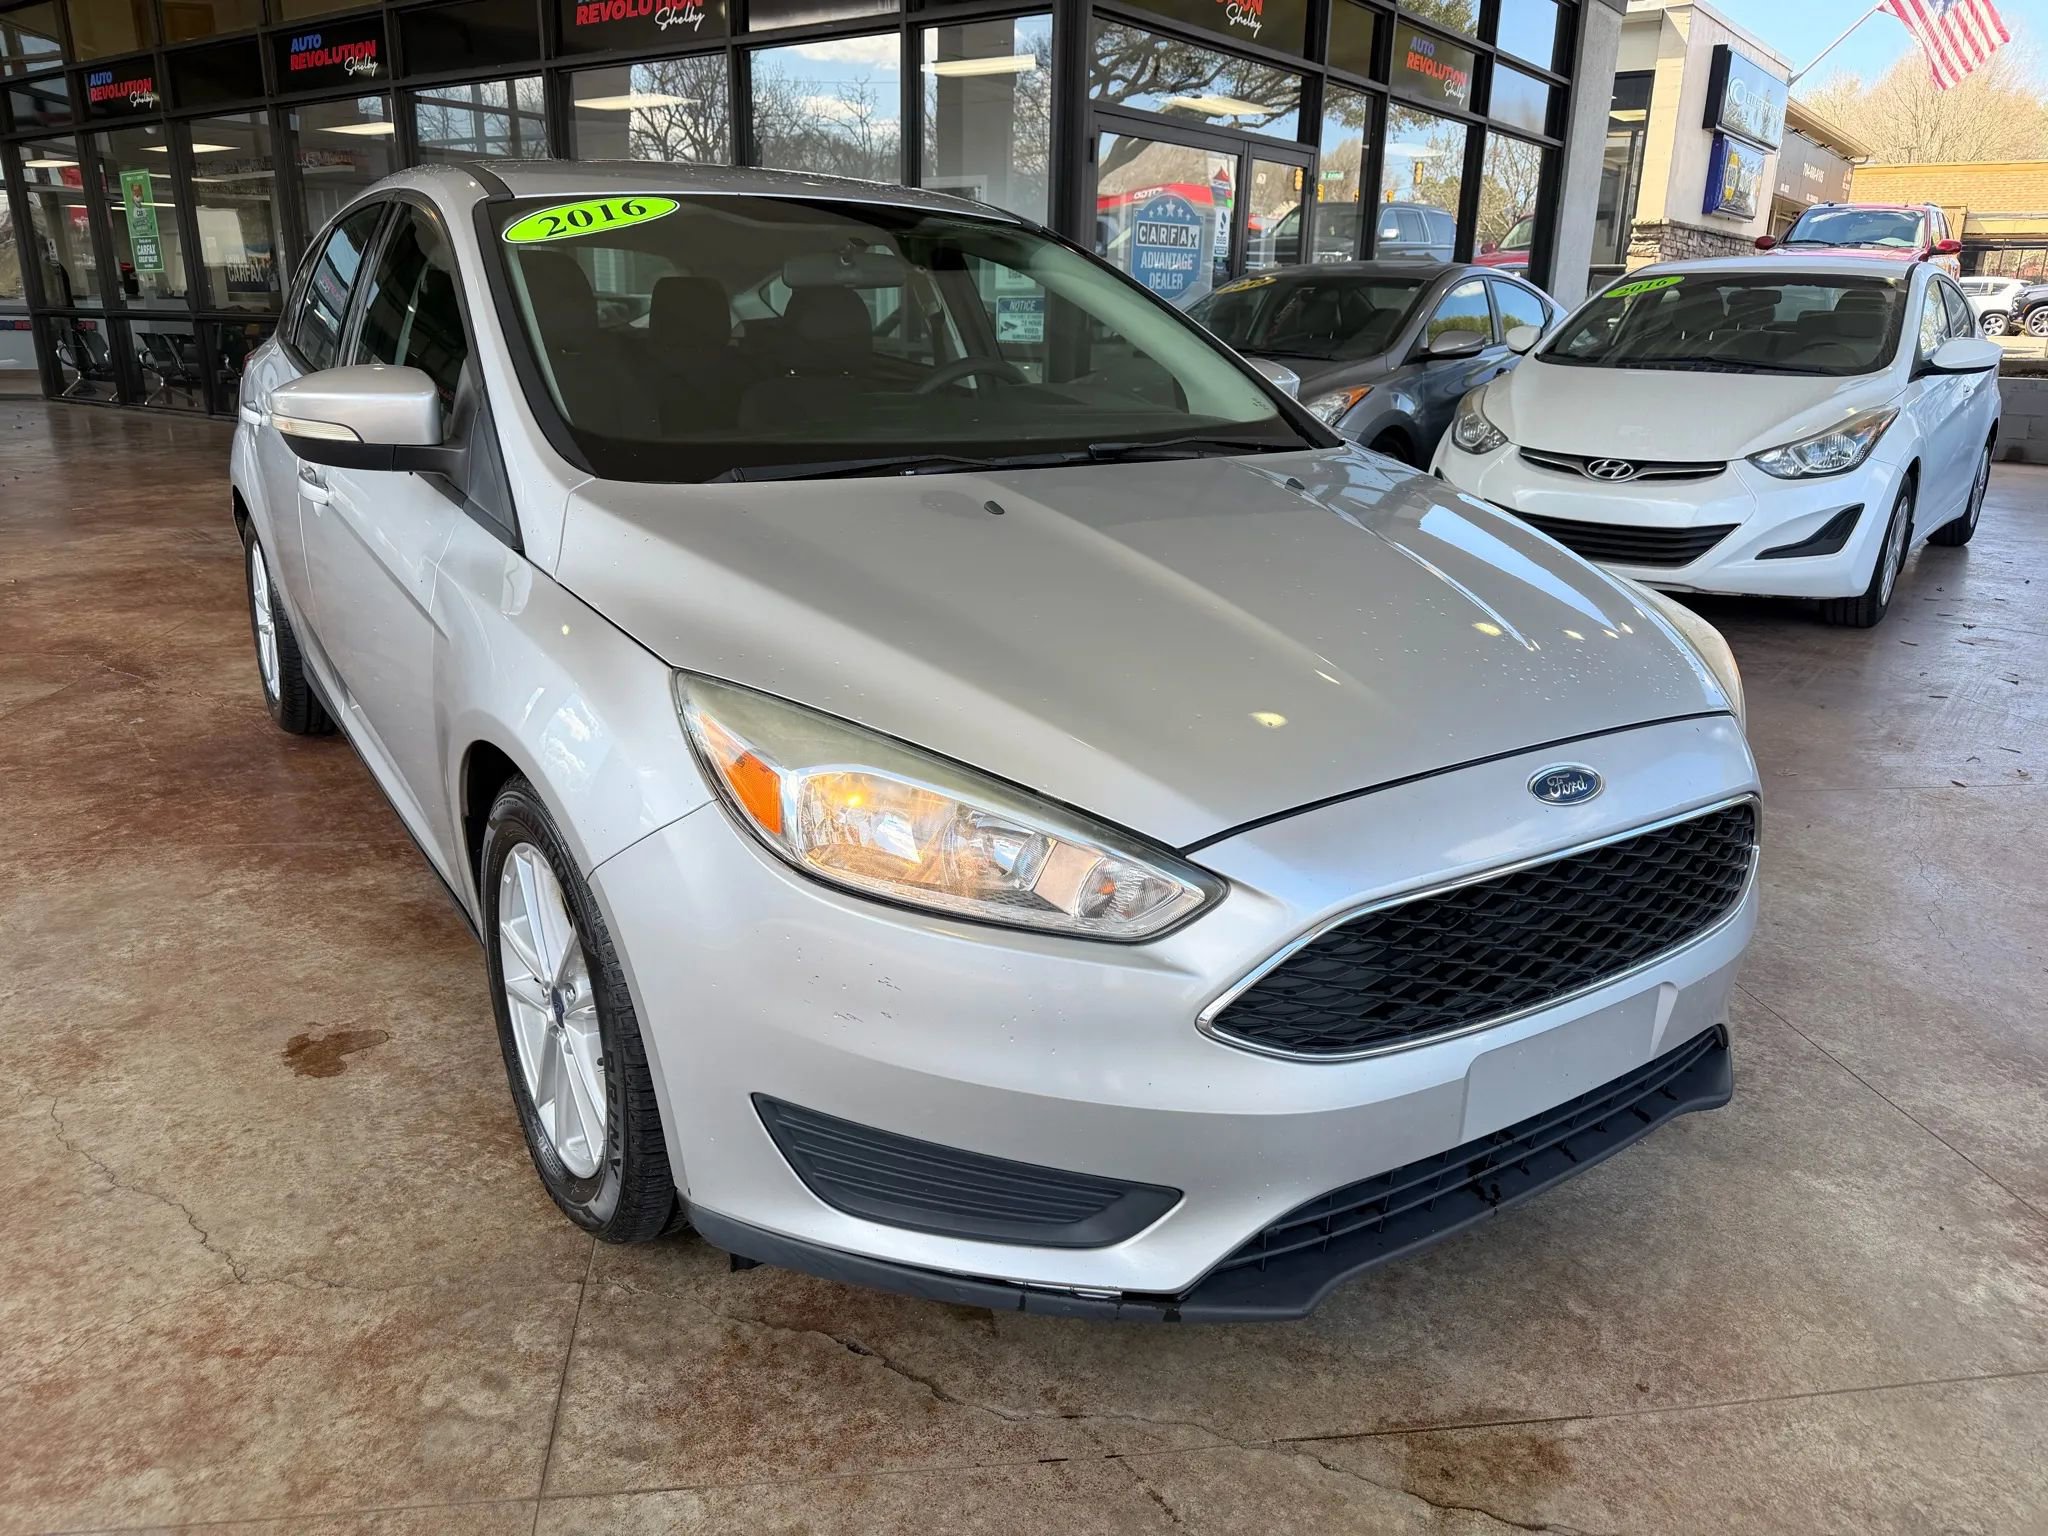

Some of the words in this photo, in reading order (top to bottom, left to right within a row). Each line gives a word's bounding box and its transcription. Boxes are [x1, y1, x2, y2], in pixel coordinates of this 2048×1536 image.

[654, 1, 705, 32] Shelby
[1225, 2, 1262, 39] Shelby
[290, 33, 322, 53] AUTO
[1409, 36, 1435, 57] AUTO
[290, 40, 377, 71] REVOLUTION
[344, 53, 378, 77] Shelby
[89, 71, 112, 87] AUTO
[1406, 50, 1468, 88] REVOLUTION
[90, 77, 152, 102] REVOLUTION
[129, 88, 154, 109] Shelby
[1443, 79, 1466, 106] Shelby
[537, 198, 648, 237] 2016
[1138, 222, 1198, 249] CARFAX
[1140, 250, 1194, 271] ADVANTAGE
[227, 263, 264, 283] CARFAX
[1148, 272, 1184, 290] DEALER
[1009, 300, 1037, 312] NOTICE
[1546, 772, 1588, 798] Ford
